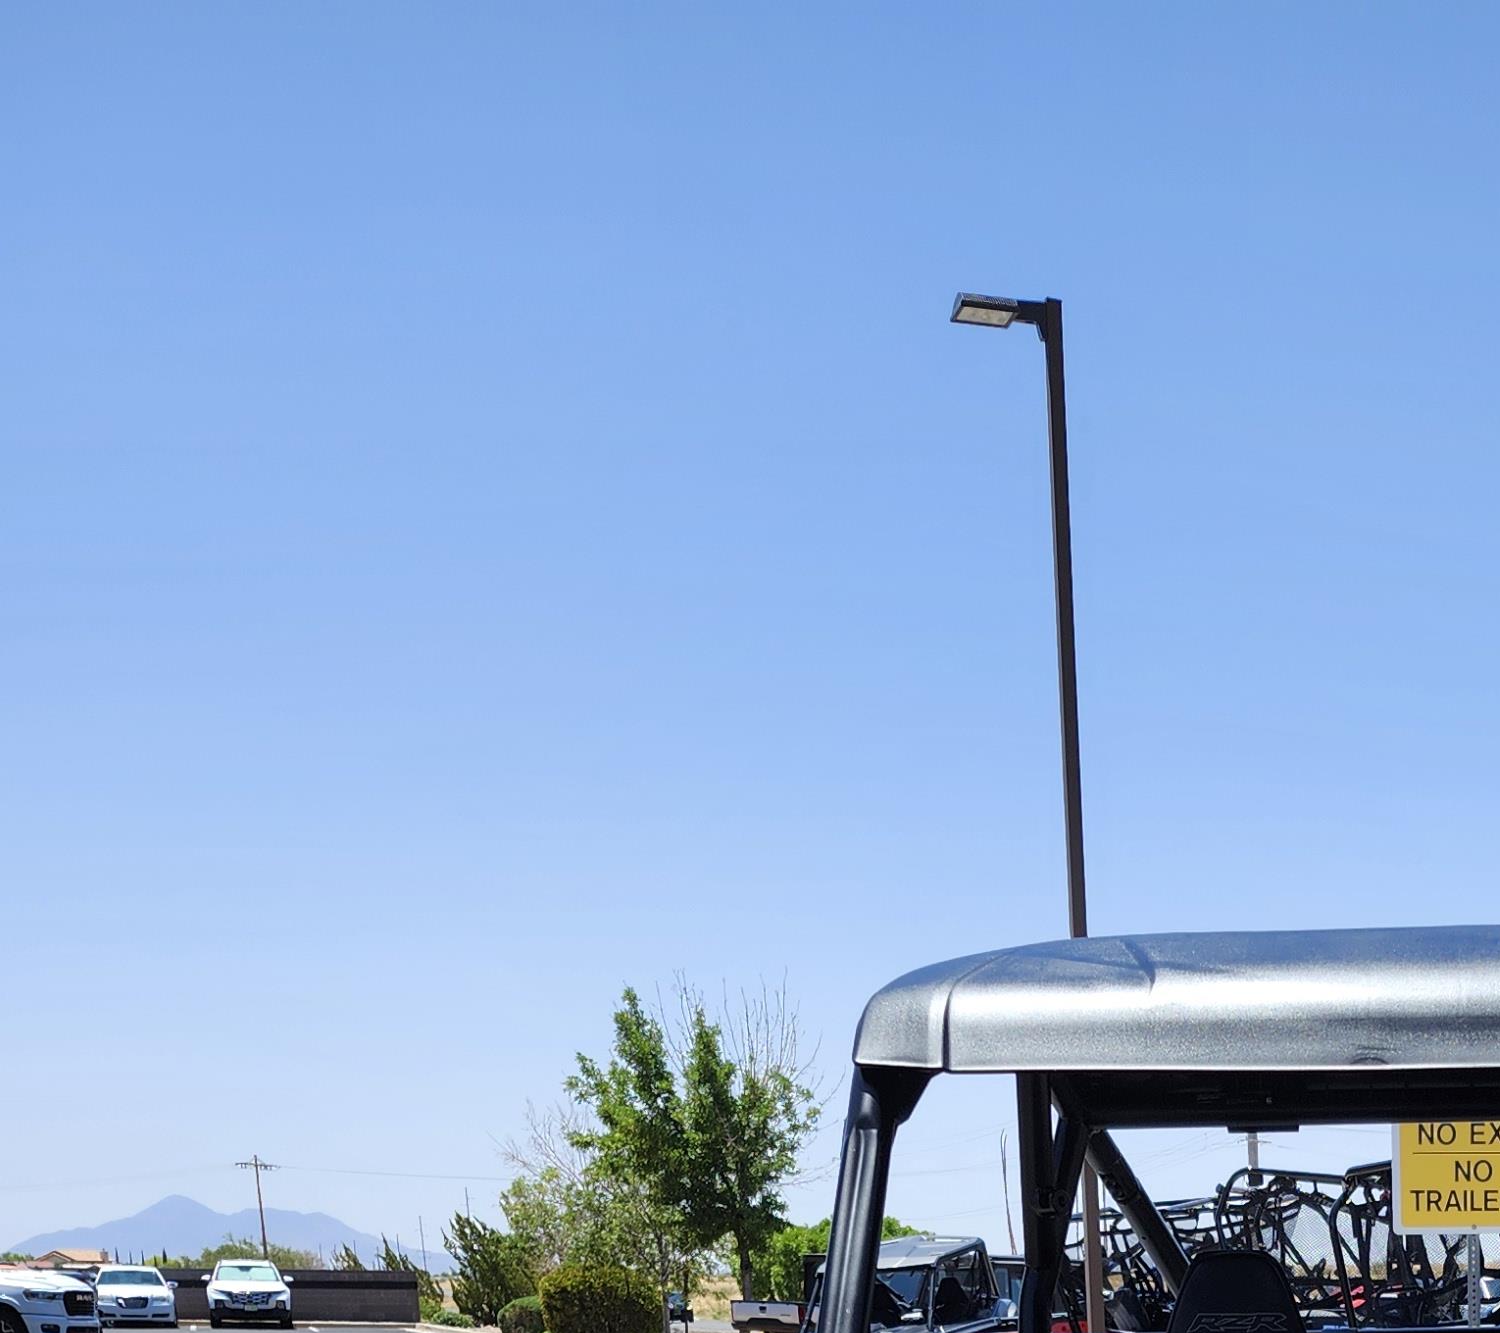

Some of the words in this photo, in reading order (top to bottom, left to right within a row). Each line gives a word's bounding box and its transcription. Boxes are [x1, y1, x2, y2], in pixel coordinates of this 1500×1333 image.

[1417, 1123, 1457, 1145] NO
[1454, 1160, 1493, 1182] NO
[1186, 1312, 1288, 1333] RZR
